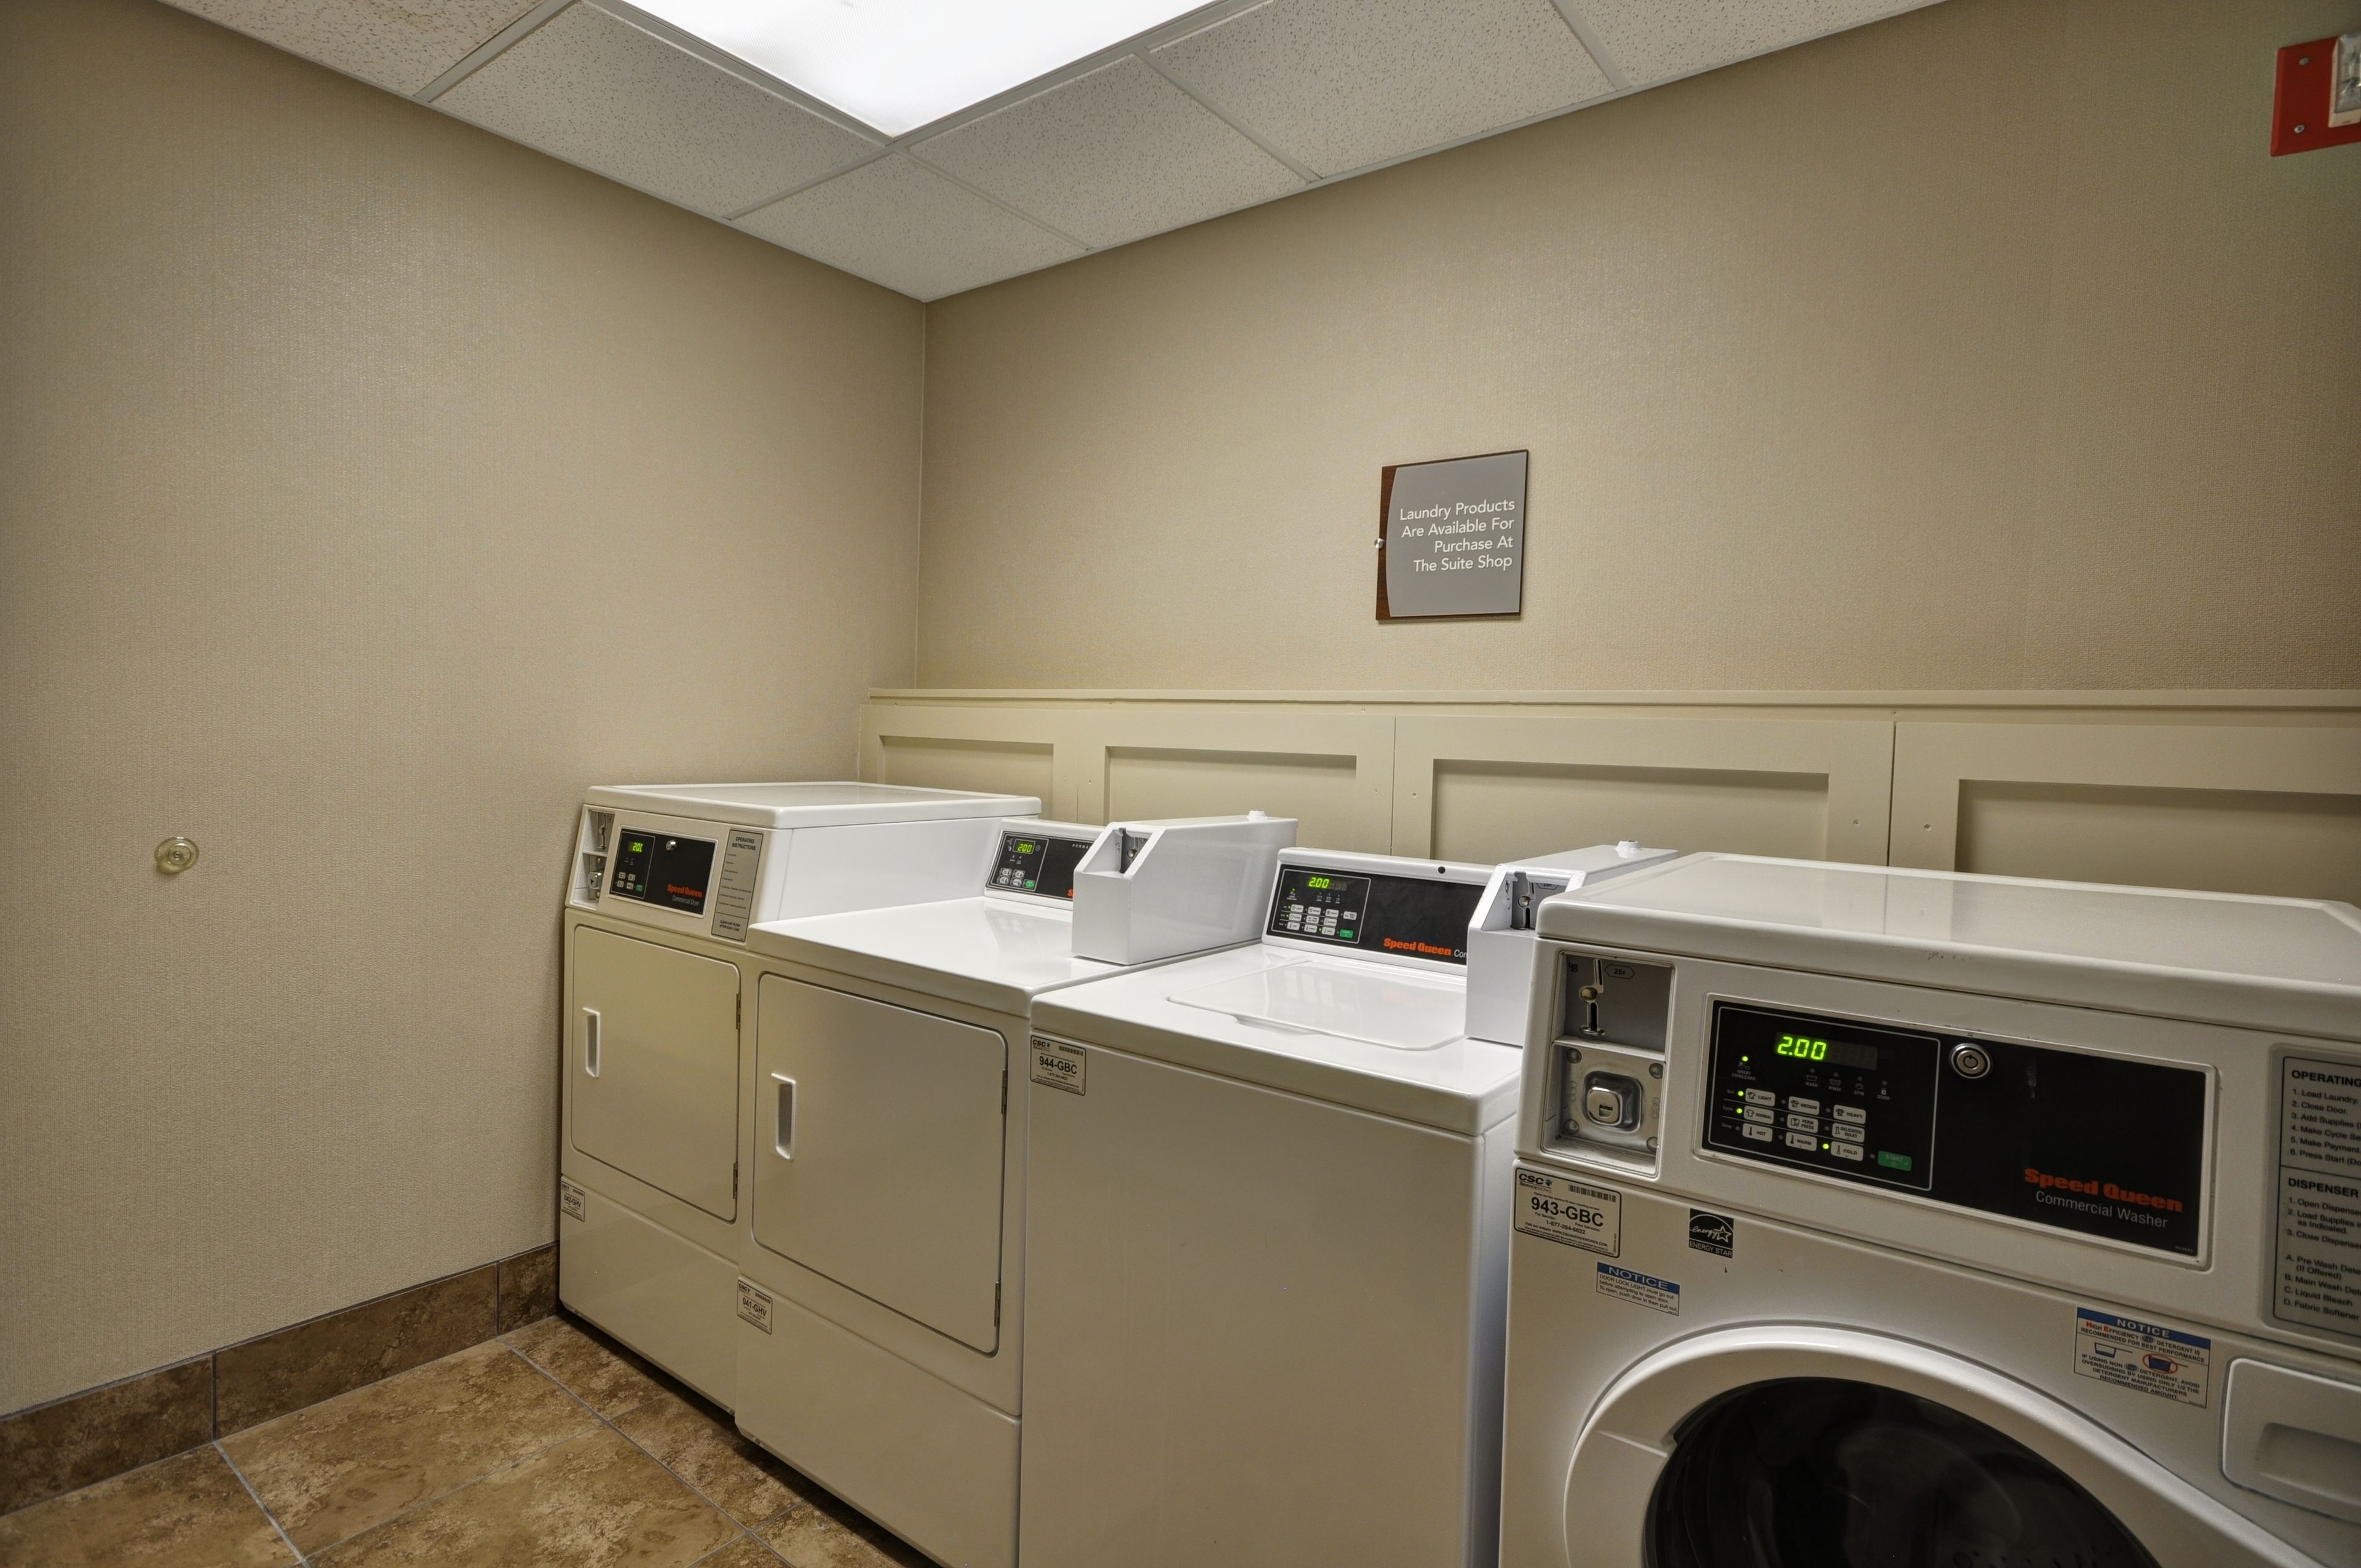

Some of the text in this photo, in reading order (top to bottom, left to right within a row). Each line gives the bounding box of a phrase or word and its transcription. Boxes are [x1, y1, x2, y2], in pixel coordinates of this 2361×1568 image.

[1400, 499, 1515, 520] Laundry Products
[1402, 517, 1514, 538] Are Available For
[1434, 536, 1513, 553] Purchase At
[1414, 555, 1513, 572] The Suite Shop
[667, 884, 702, 897] Speed Queen
[1308, 877, 1329, 888] 2.00
[672, 895, 690, 904] Commercial
[1383, 938, 1417, 949] Speed
[1418, 942, 1451, 956] Queen
[1778, 1036, 1826, 1060] 2.00
[1039, 1056, 1077, 1074] 944-GBC
[2292, 1070, 2361, 1087] OPERATING
[2302, 1090, 2322, 1098] Load
[2324, 1094, 2359, 1105] Laundry.
[2301, 1102, 2324, 1111] Close
[2327, 1106, 2347, 1114] Door.
[2319, 1117, 2354, 1127] Supplies
[2301, 1125, 2322, 1135] Make
[2325, 1130, 2347, 1139] Cycle
[2300, 1138, 2322, 1147] Make
[2300, 1150, 2322, 1160] Press
[2325, 1154, 2344, 1163] Start
[1519, 1173, 1544, 1185] CSC
[2024, 1168, 2183, 1213] Speed Queen
[2288, 1178, 2359, 1198] DISPENSER
[1531, 1197, 1604, 1227] 943-GBC
[2036, 1190, 2168, 1228] Commercial Washer
[2298, 1198, 2320, 1210] Open
[2297, 1210, 2317, 1221] Load
[2320, 1214, 2355, 1229] Supplies
[2309, 1221, 2349, 1235] Indicated.
[2296, 1230, 2319, 1241] Close
[1690, 1241, 1733, 1257] ENERGY STAR
[2297, 1256, 2312, 1265] Pre
[2314, 1259, 2338, 1271] Wash
[1608, 1266, 1668, 1290] NOTICE
[2296, 1265, 2306, 1273] (If
[2307, 1266, 2342, 1281] Offered)
[1615, 1284, 1638, 1296] attempting
[2295, 1275, 2316, 1286] Main
[2319, 1280, 2342, 1293] Wash
[2295, 1288, 2321, 1301] Liquid
[2323, 1293, 2353, 1307] Bleach
[2284, 1298, 2359, 1321] D. Fabric Softener
[2117, 1318, 2170, 1338] NOTICE
[2081, 1328, 2126, 1343] RECOMMENDED
[2159, 1346, 2205, 1363] PERFORMANCE
[2086, 1321, 2102, 1331] HIGH
[2103, 1326, 2140, 1340] EFFICIENCY
[2156, 1340, 2193, 1353] DETERGENT
[2089, 1355, 2108, 1364] USING
[2181, 1379, 2200, 1388] AVOID
[2138, 1373, 2157, 1383] USING
[2159, 1379, 2175, 1387] ONLY
[2092, 1368, 2187, 1396] DETERGENT MANUFACTURERS
[2100, 1375, 2149, 1392] RECOMMENDED
